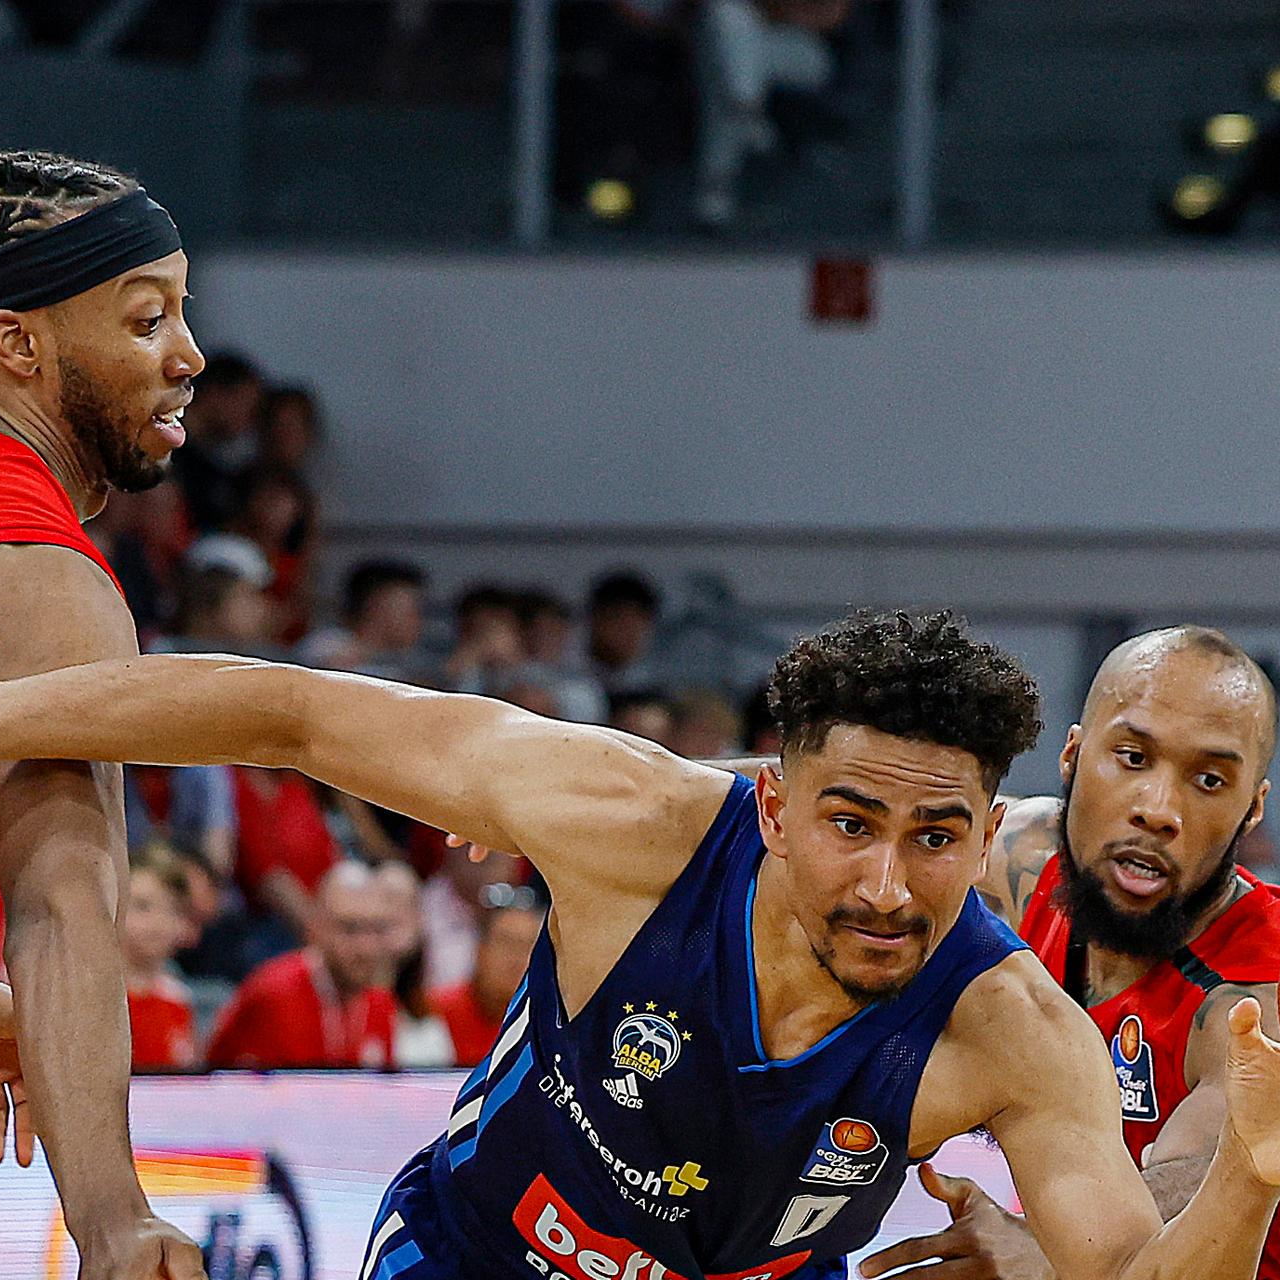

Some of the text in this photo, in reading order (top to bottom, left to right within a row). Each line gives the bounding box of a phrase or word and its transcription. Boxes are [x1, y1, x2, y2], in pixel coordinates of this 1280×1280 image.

[618, 1044, 662, 1074] ALBA
[619, 1056, 655, 1078] BERLIN
[539, 1075, 567, 1109] Die
[602, 1078, 644, 1110] adidas
[806, 1164, 865, 1181] BBL
